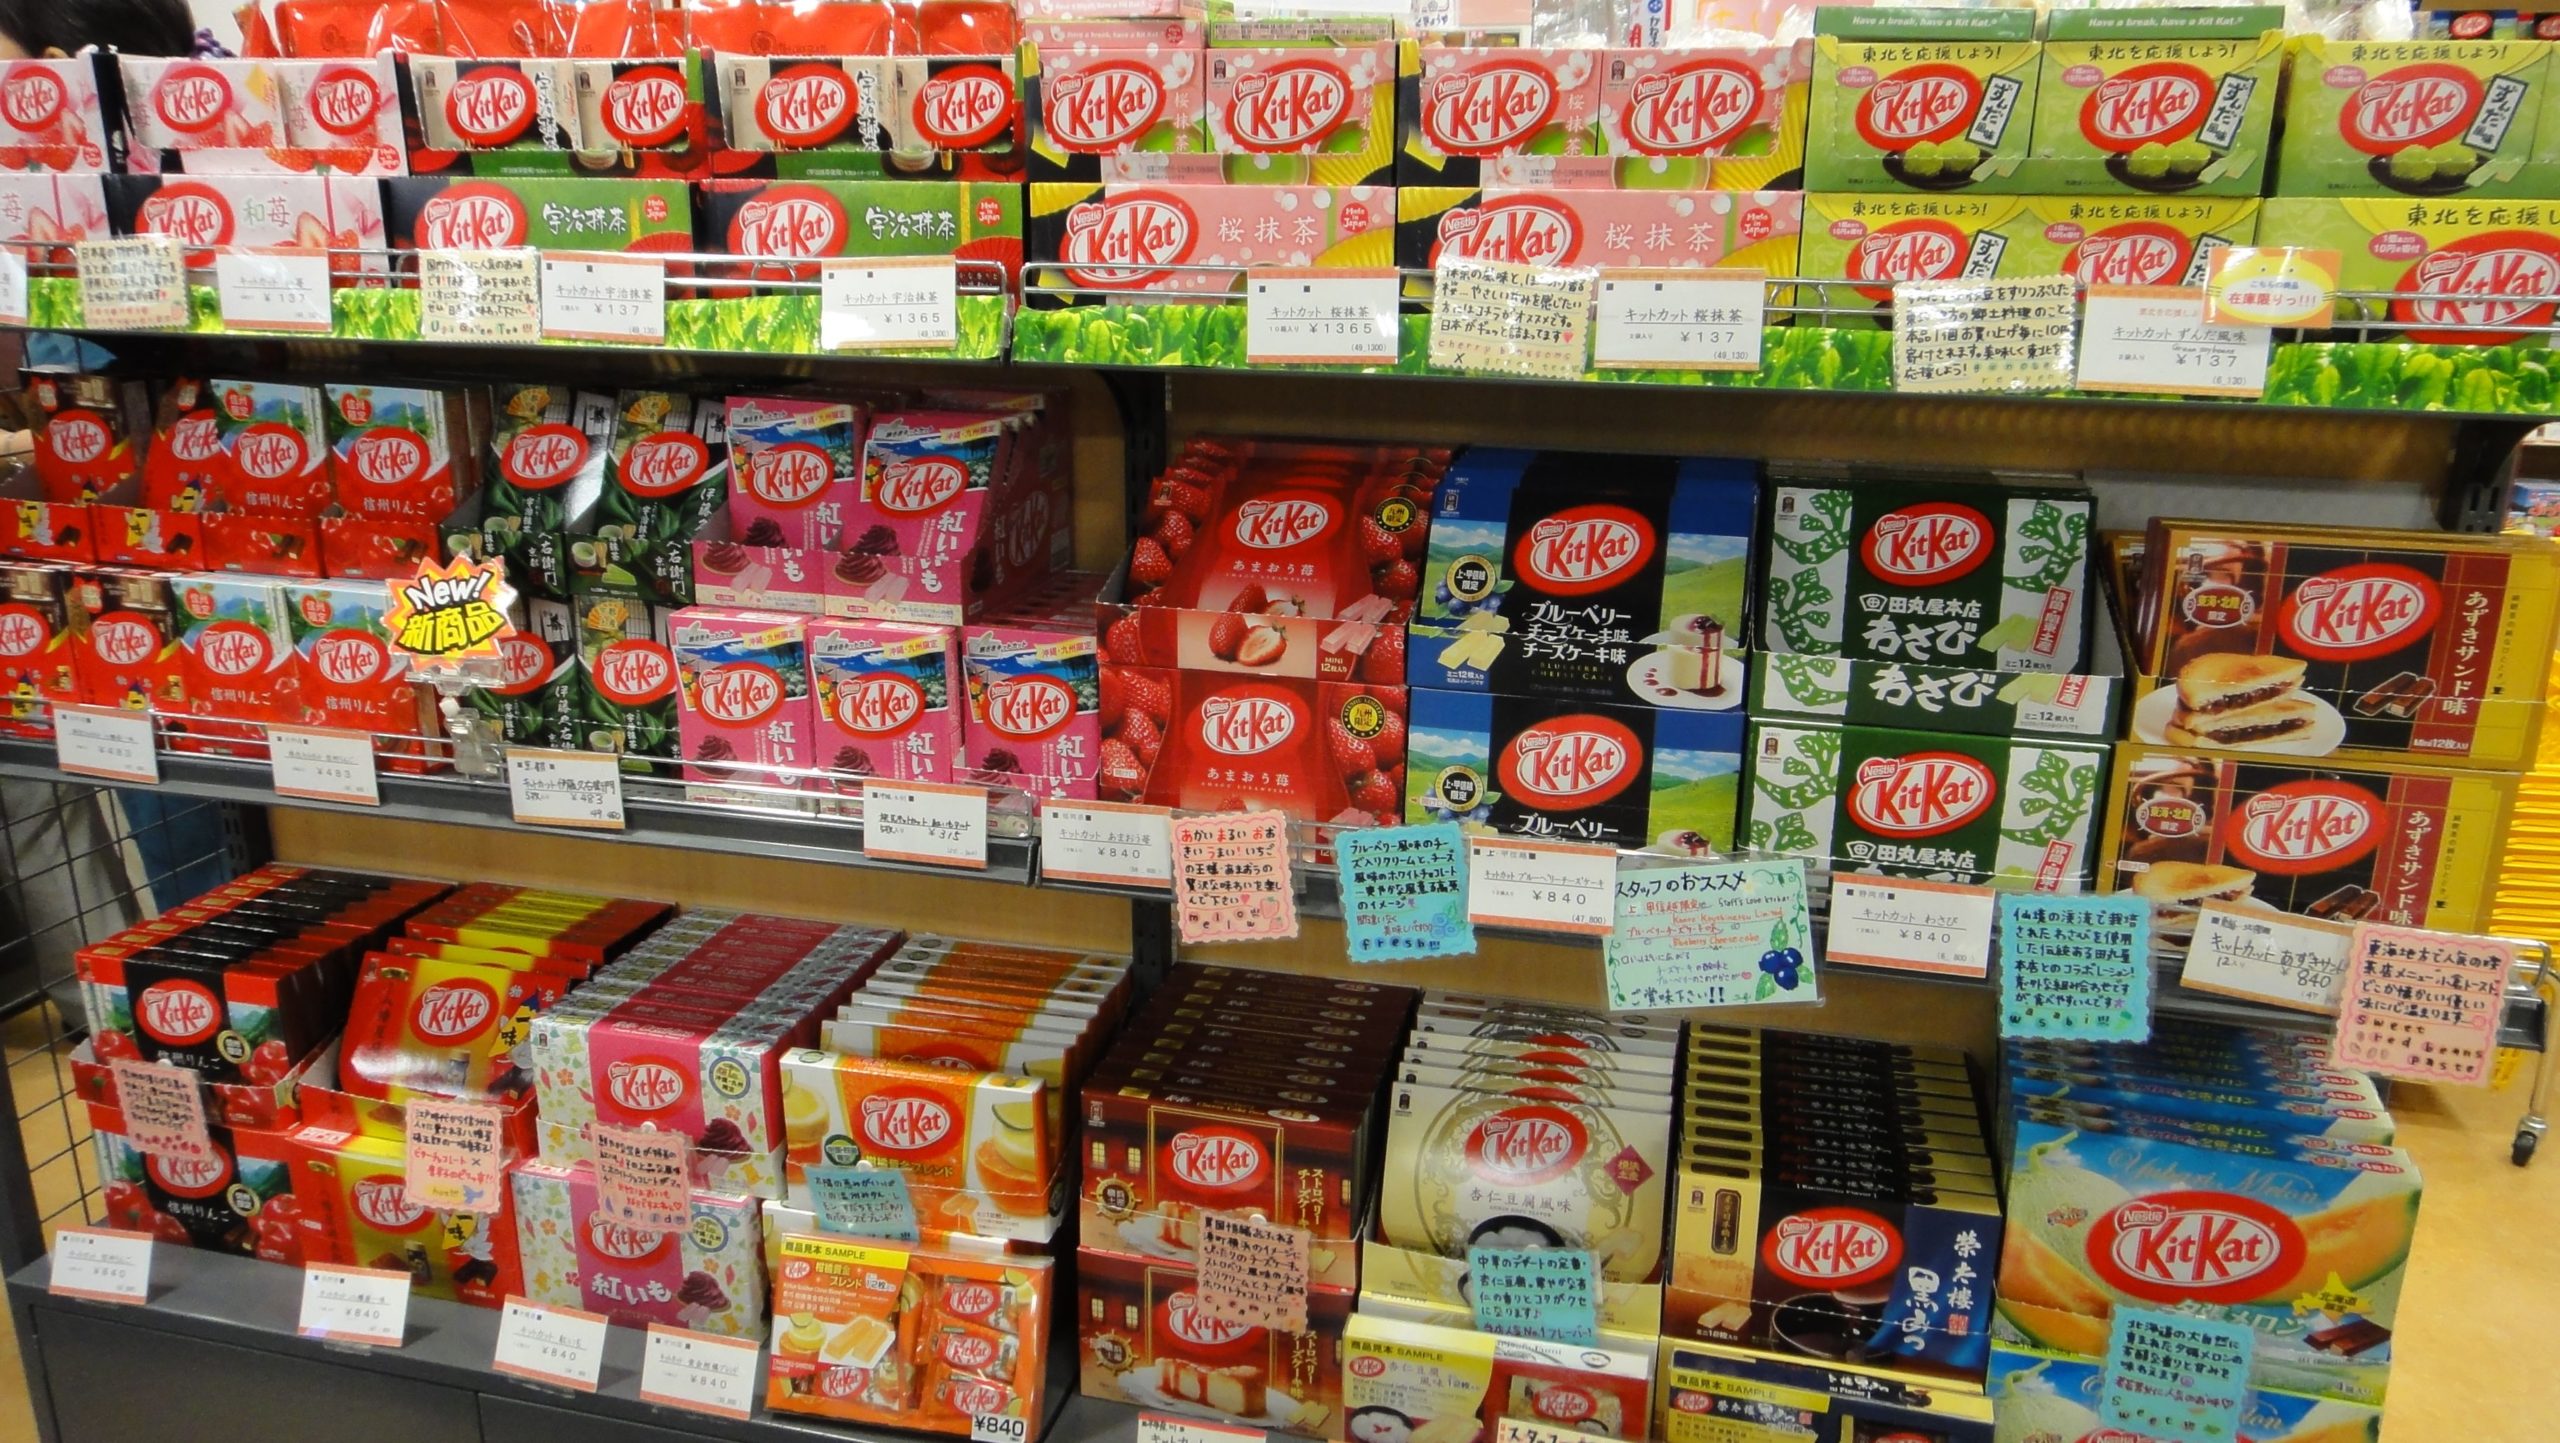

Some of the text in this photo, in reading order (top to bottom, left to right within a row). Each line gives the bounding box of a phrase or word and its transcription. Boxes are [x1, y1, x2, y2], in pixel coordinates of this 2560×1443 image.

[1863, 46, 2002, 62] 東北を応援しよう!
[2088, 45, 2236, 61] 東北を応援しよう!
[2352, 45, 2508, 61] 東北を応援しよう!
[172, 76, 224, 127] KitKat
[327, 76, 367, 119] KitKat
[467, 79, 518, 129] KitKat
[623, 79, 677, 129] KitKat
[780, 79, 837, 132] KitKat
[938, 80, 996, 132] KitKat
[1068, 75, 1147, 138] KitKat
[1250, 75, 1333, 139] KitKat
[1450, 75, 1537, 140] KitKat
[1649, 75, 1741, 143] KitKat
[1884, 82, 1958, 134] KitKat
[2108, 82, 2188, 134] KitKat
[2372, 81, 2457, 138] KitKat
[1175, 92, 1190, 151] 桜抹茶
[1567, 94, 1584, 155] 桜抹茶
[543, 205, 627, 234] 宇治抹茶
[865, 207, 955, 240] 宇治抹茶
[1852, 202, 1988, 216] 東北を応援しよう!
[2069, 203, 2212, 219] 東北を応援しよう!
[1218, 216, 1318, 244] 桜抹茶
[1605, 223, 1716, 252] 桜抹茶
[556, 286, 652, 300] キットカット 宇治抹茶
[844, 292, 938, 304] キットカット 宇治抹茶
[594, 304, 640, 316] ¥137
[884, 313, 940, 323] ¥1365
[1271, 306, 1369, 318] キットカット 桜抹茶
[1625, 308, 1743, 322] キットカット 桜抹茶
[2113, 327, 2247, 342] キットカット ずんだ風味
[2176, 354, 2237, 367] ¥137
[249, 434, 294, 473] KitKat
[367, 439, 416, 479] KitKat
[522, 437, 570, 475] KitKat
[641, 445, 691, 483] KitKat
[765, 455, 821, 498] KitKat
[893, 464, 956, 507] KitKat
[246, 491, 304, 512] 信州りんご
[363, 497, 426, 516] 信州りんご
[1248, 503, 1320, 544] KitKat
[1545, 522, 1628, 578] KitKat
[1890, 518, 1970, 570] KitKat
[1233, 560, 1315, 576] あまおう苺
[406, 570, 493, 610] New!
[1461, 581, 1479, 591] 限定
[1530, 602, 1632, 626] ブルーベリー
[1888, 597, 1983, 618] 田丸屋本店
[2311, 581, 2413, 643] KitKat
[398, 601, 505, 650] 新商品
[1862, 614, 1977, 662] わさび
[1523, 642, 1627, 665] チーズケーキ味
[2442, 591, 2490, 716] あずきサンド味
[211, 687, 271, 706] 信州りんご
[713, 669, 771, 717] KitKat
[1870, 664, 1997, 712] わさび
[325, 695, 388, 715] 信州りんご
[852, 679, 911, 730] KitKat
[1002, 682, 1063, 734] KitKat
[1217, 701, 1286, 751] KitKat
[316, 767, 352, 780] ¥483
[1207, 768, 1289, 786] あまおう苺
[1534, 736, 1615, 790] KitKat
[1450, 790, 1468, 801] 限定
[1874, 764, 1975, 825] KitKat
[1060, 829, 1151, 845] キットカット あまおう苺
[1181, 825, 1276, 841] あかい まるい おお
[1519, 813, 1619, 837] ブルーベリー
[2262, 800, 2359, 854] KitKat
[1098, 847, 1141, 859] ¥840
[1877, 845, 1977, 869] 田丸屋本店
[2389, 810, 2431, 925] あずきサンド味
[1485, 870, 1515, 880] キットカット
[1189, 893, 1239, 905] んで下さい
[1532, 890, 1586, 904] ¥840
[1863, 908, 1958, 927] キットカット わさび
[1899, 929, 1951, 944] ¥840
[2211, 933, 2274, 960] キットカット
[156, 992, 209, 1036] KitKat
[429, 991, 483, 1035] KitKat
[2374, 1033, 2483, 1058] red beans
[2410, 1056, 2474, 1072] paste
[622, 1068, 676, 1106] KitKat
[877, 1102, 942, 1146] KitKat
[1186, 1139, 1250, 1182] KitKat
[1496, 1122, 1564, 1169] KitKat
[1312, 1169, 1323, 1224] ストロベリー
[1470, 1187, 1573, 1213] 杏仁豆腐風味
[825, 1247, 865, 1260] SAMPLE
[1793, 1224, 1876, 1272] KitKat
[2135, 1216, 2263, 1281] KitKat
[592, 1273, 672, 1305] 紅いも
[345, 1306, 381, 1320] ¥840
[541, 1346, 577, 1361] ¥840
[1306, 1331, 1317, 1384] ストロベリー
[1397, 1348, 1444, 1361] SAMPLE
[689, 1373, 727, 1389] ¥840
[1726, 1383, 1777, 1399] SAMPLE
[974, 1415, 1024, 1436] ¥840
